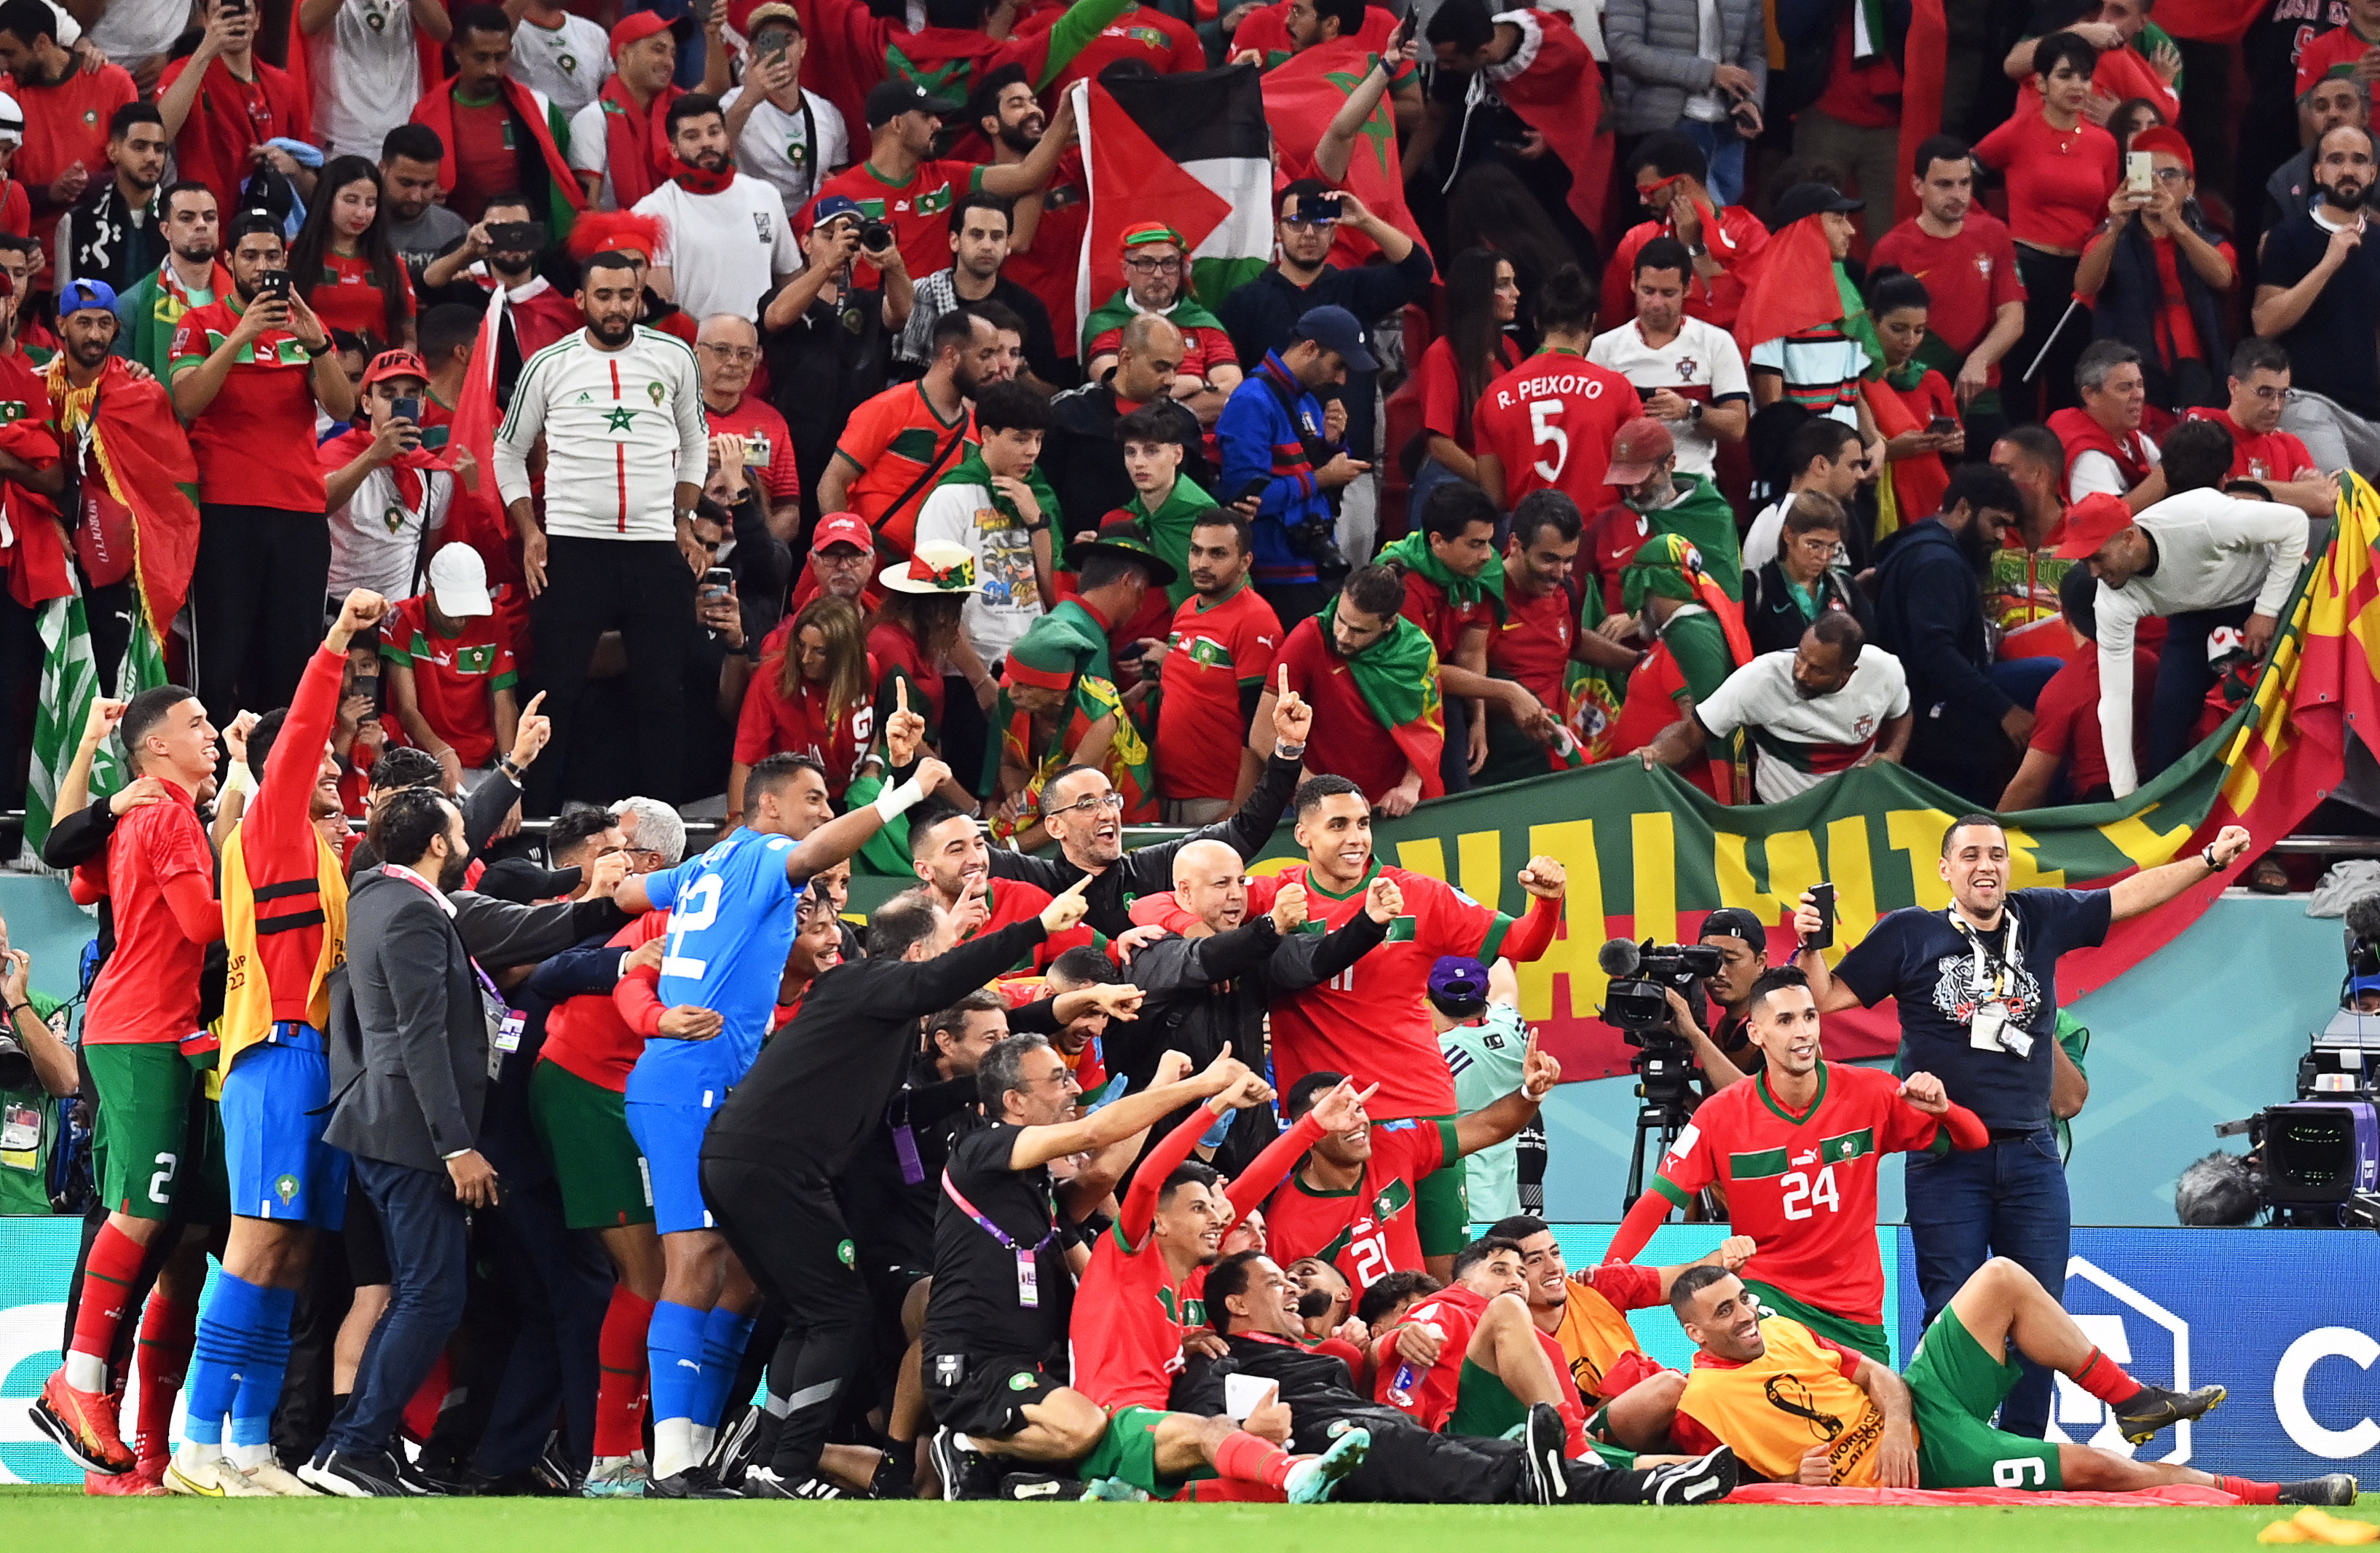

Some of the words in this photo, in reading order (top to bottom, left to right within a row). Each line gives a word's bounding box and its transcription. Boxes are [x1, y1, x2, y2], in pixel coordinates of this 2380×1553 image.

[1497, 390, 1517, 410] R.
[1518, 374, 1604, 400] PEIXOTO
[1529, 398, 1569, 483] 5
[87, 499, 110, 563] MOROCCO
[228, 955, 246, 973] UP
[148, 1152, 177, 1204] 2
[1780, 1165, 1840, 1221] 24
[1351, 1231, 1395, 1289] 21
[1828, 1424, 1869, 1465] WORLD
